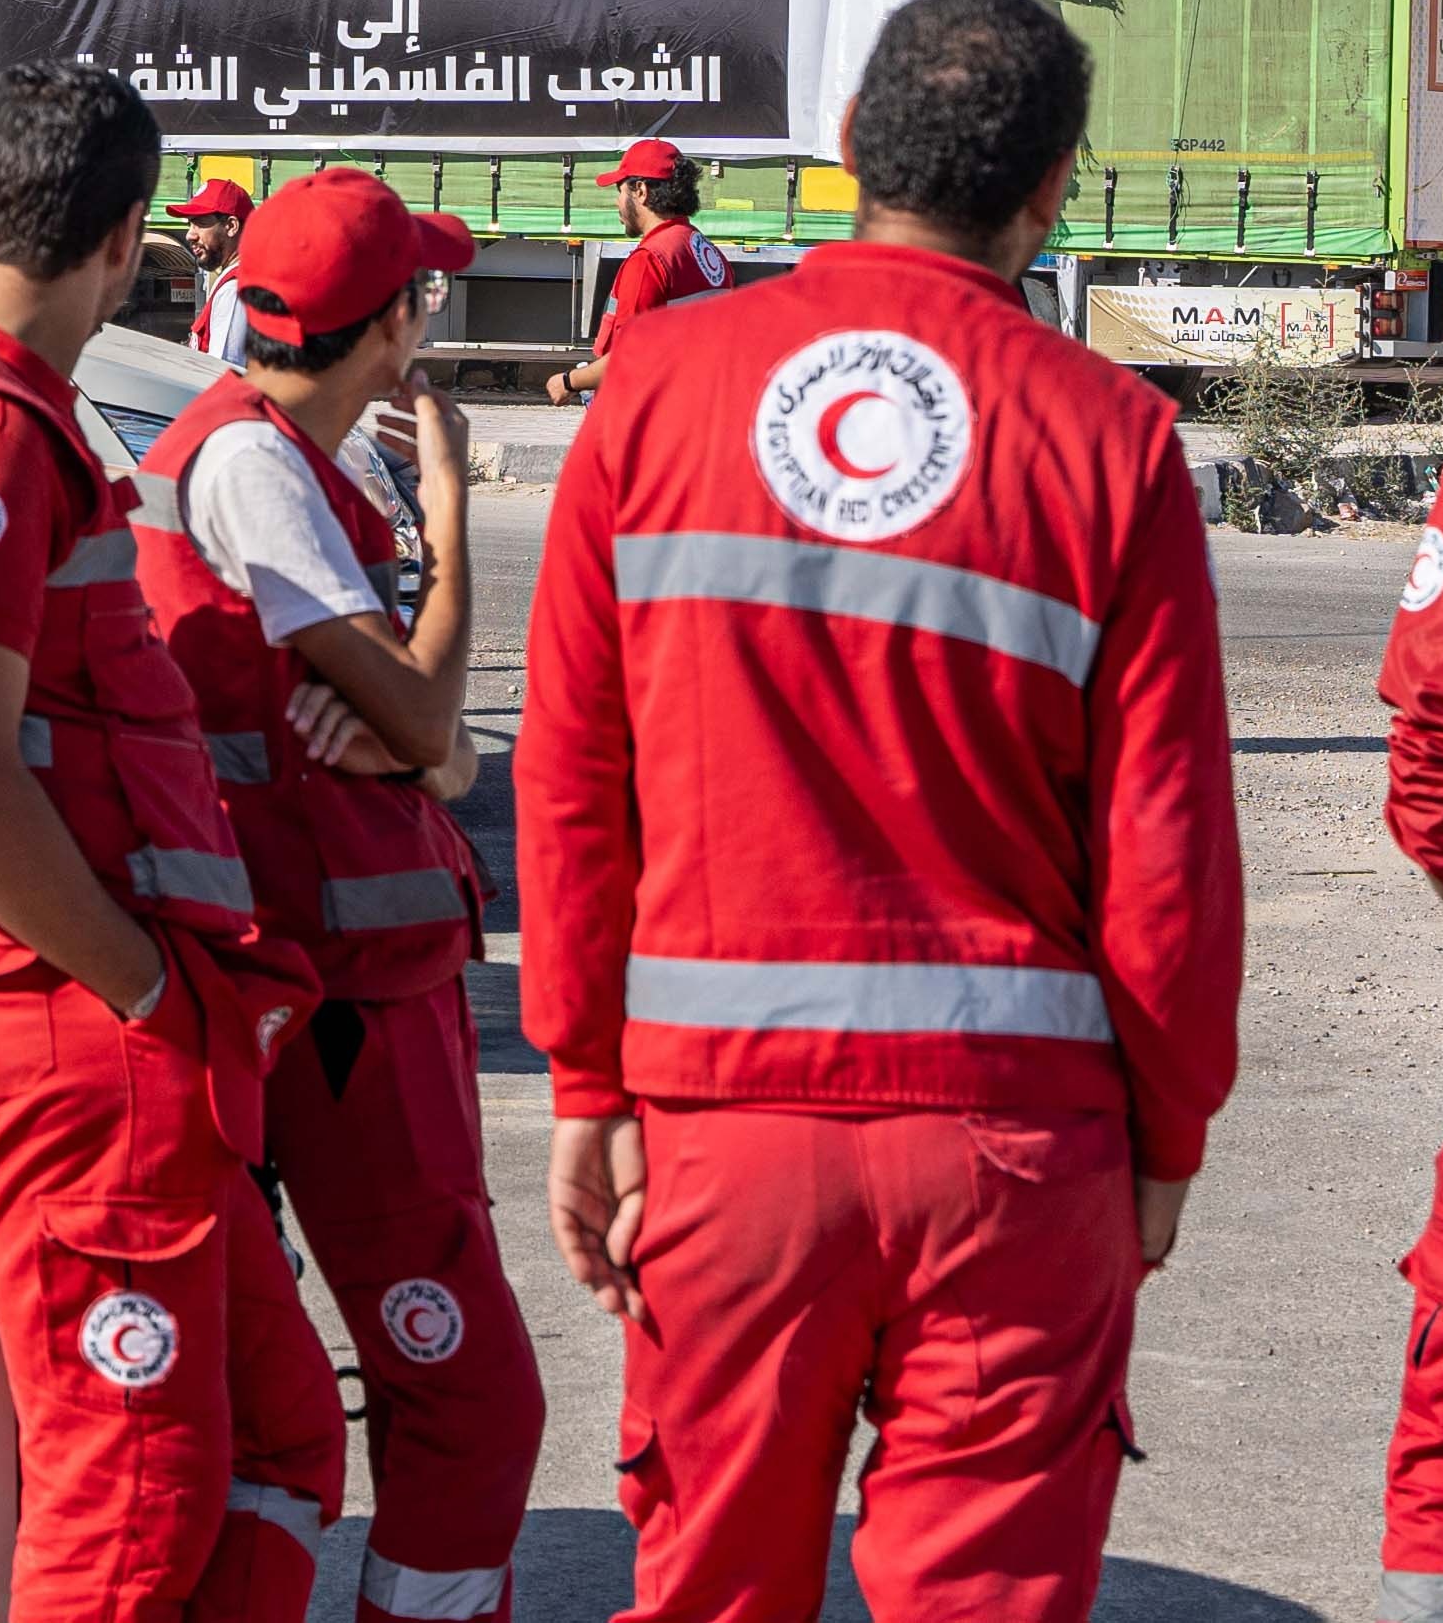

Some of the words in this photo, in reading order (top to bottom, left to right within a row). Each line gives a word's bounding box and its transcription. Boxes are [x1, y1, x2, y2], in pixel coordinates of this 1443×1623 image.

[77, 44, 238, 101] الشق
[254, 51, 531, 130] الفلسطيني
[548, 42, 721, 117] الشعب
[1171, 329, 1204, 345] النقل
[1172, 306, 1261, 325] M.A.M
